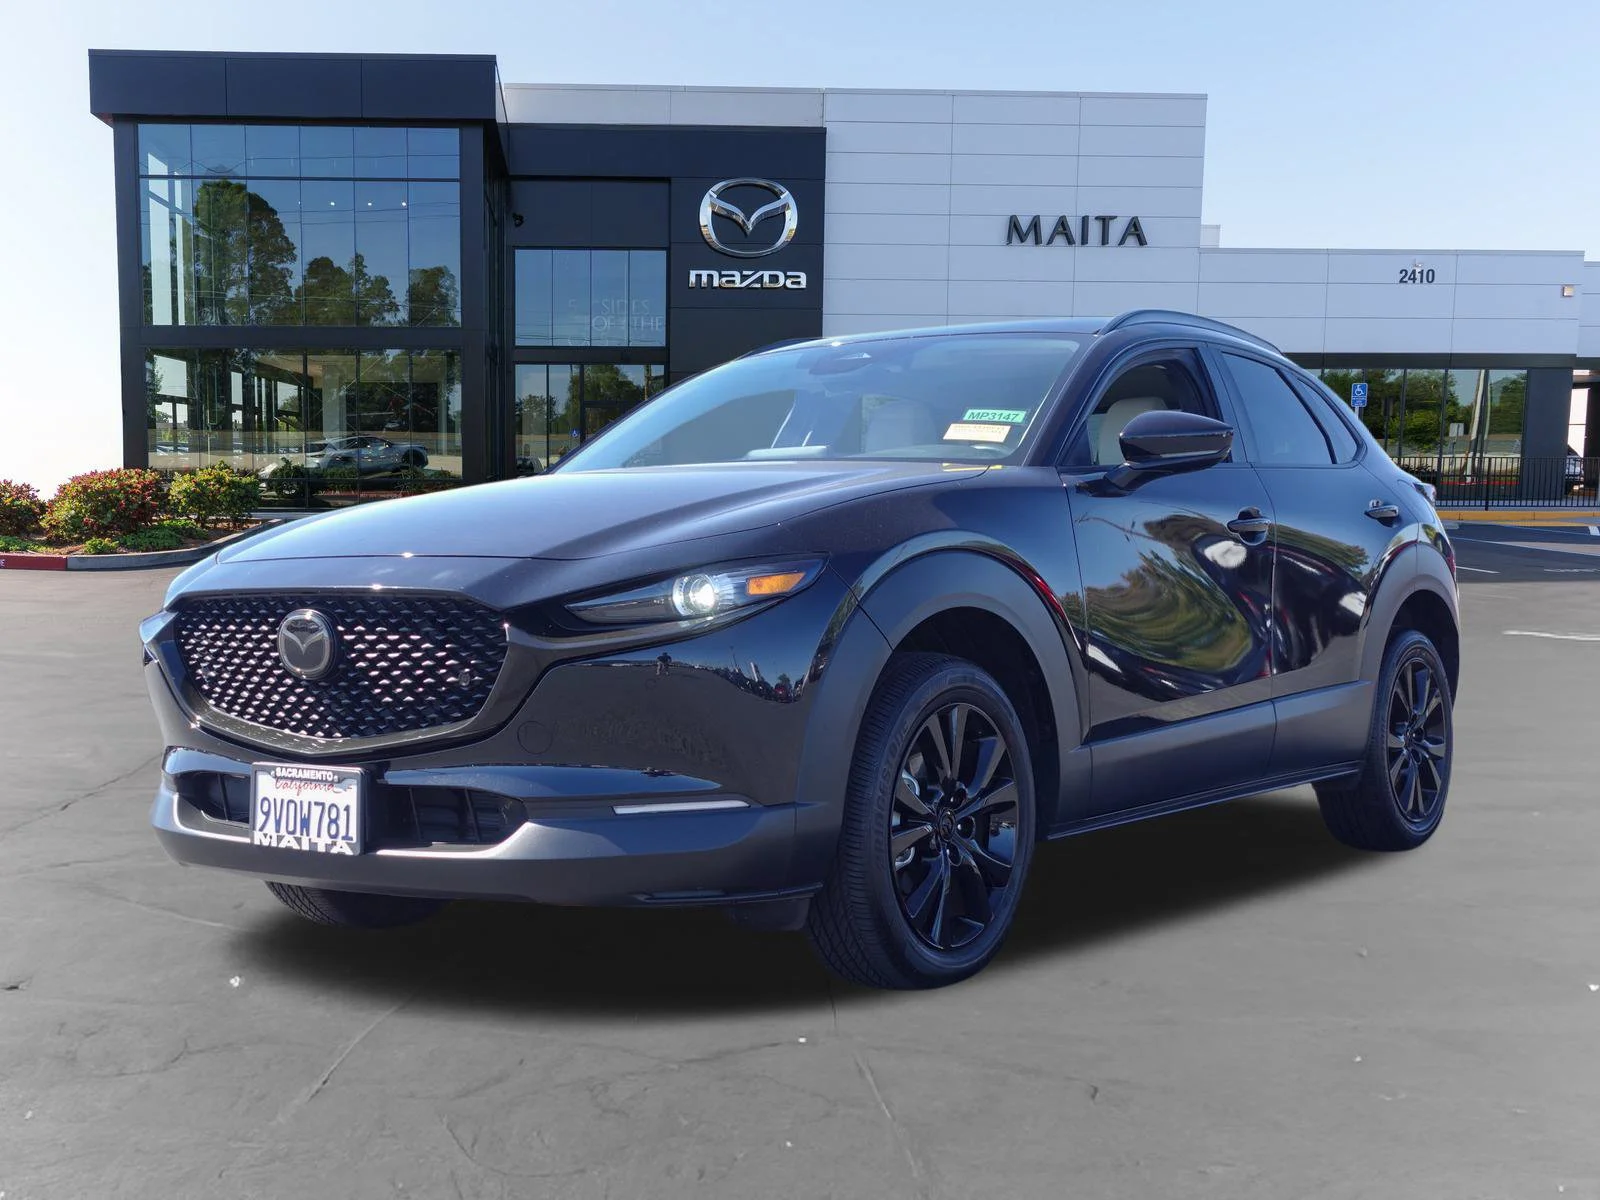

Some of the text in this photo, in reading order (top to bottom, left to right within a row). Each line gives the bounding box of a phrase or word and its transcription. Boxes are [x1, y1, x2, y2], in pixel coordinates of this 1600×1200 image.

[1006, 214, 1148, 246] MAITA
[1399, 269, 1435, 284] 2410
[968, 411, 1019, 422] MP3147
[275, 767, 333, 781] SACRAMENTO
[275, 778, 335, 796] California
[254, 831, 354, 856] MAITA
